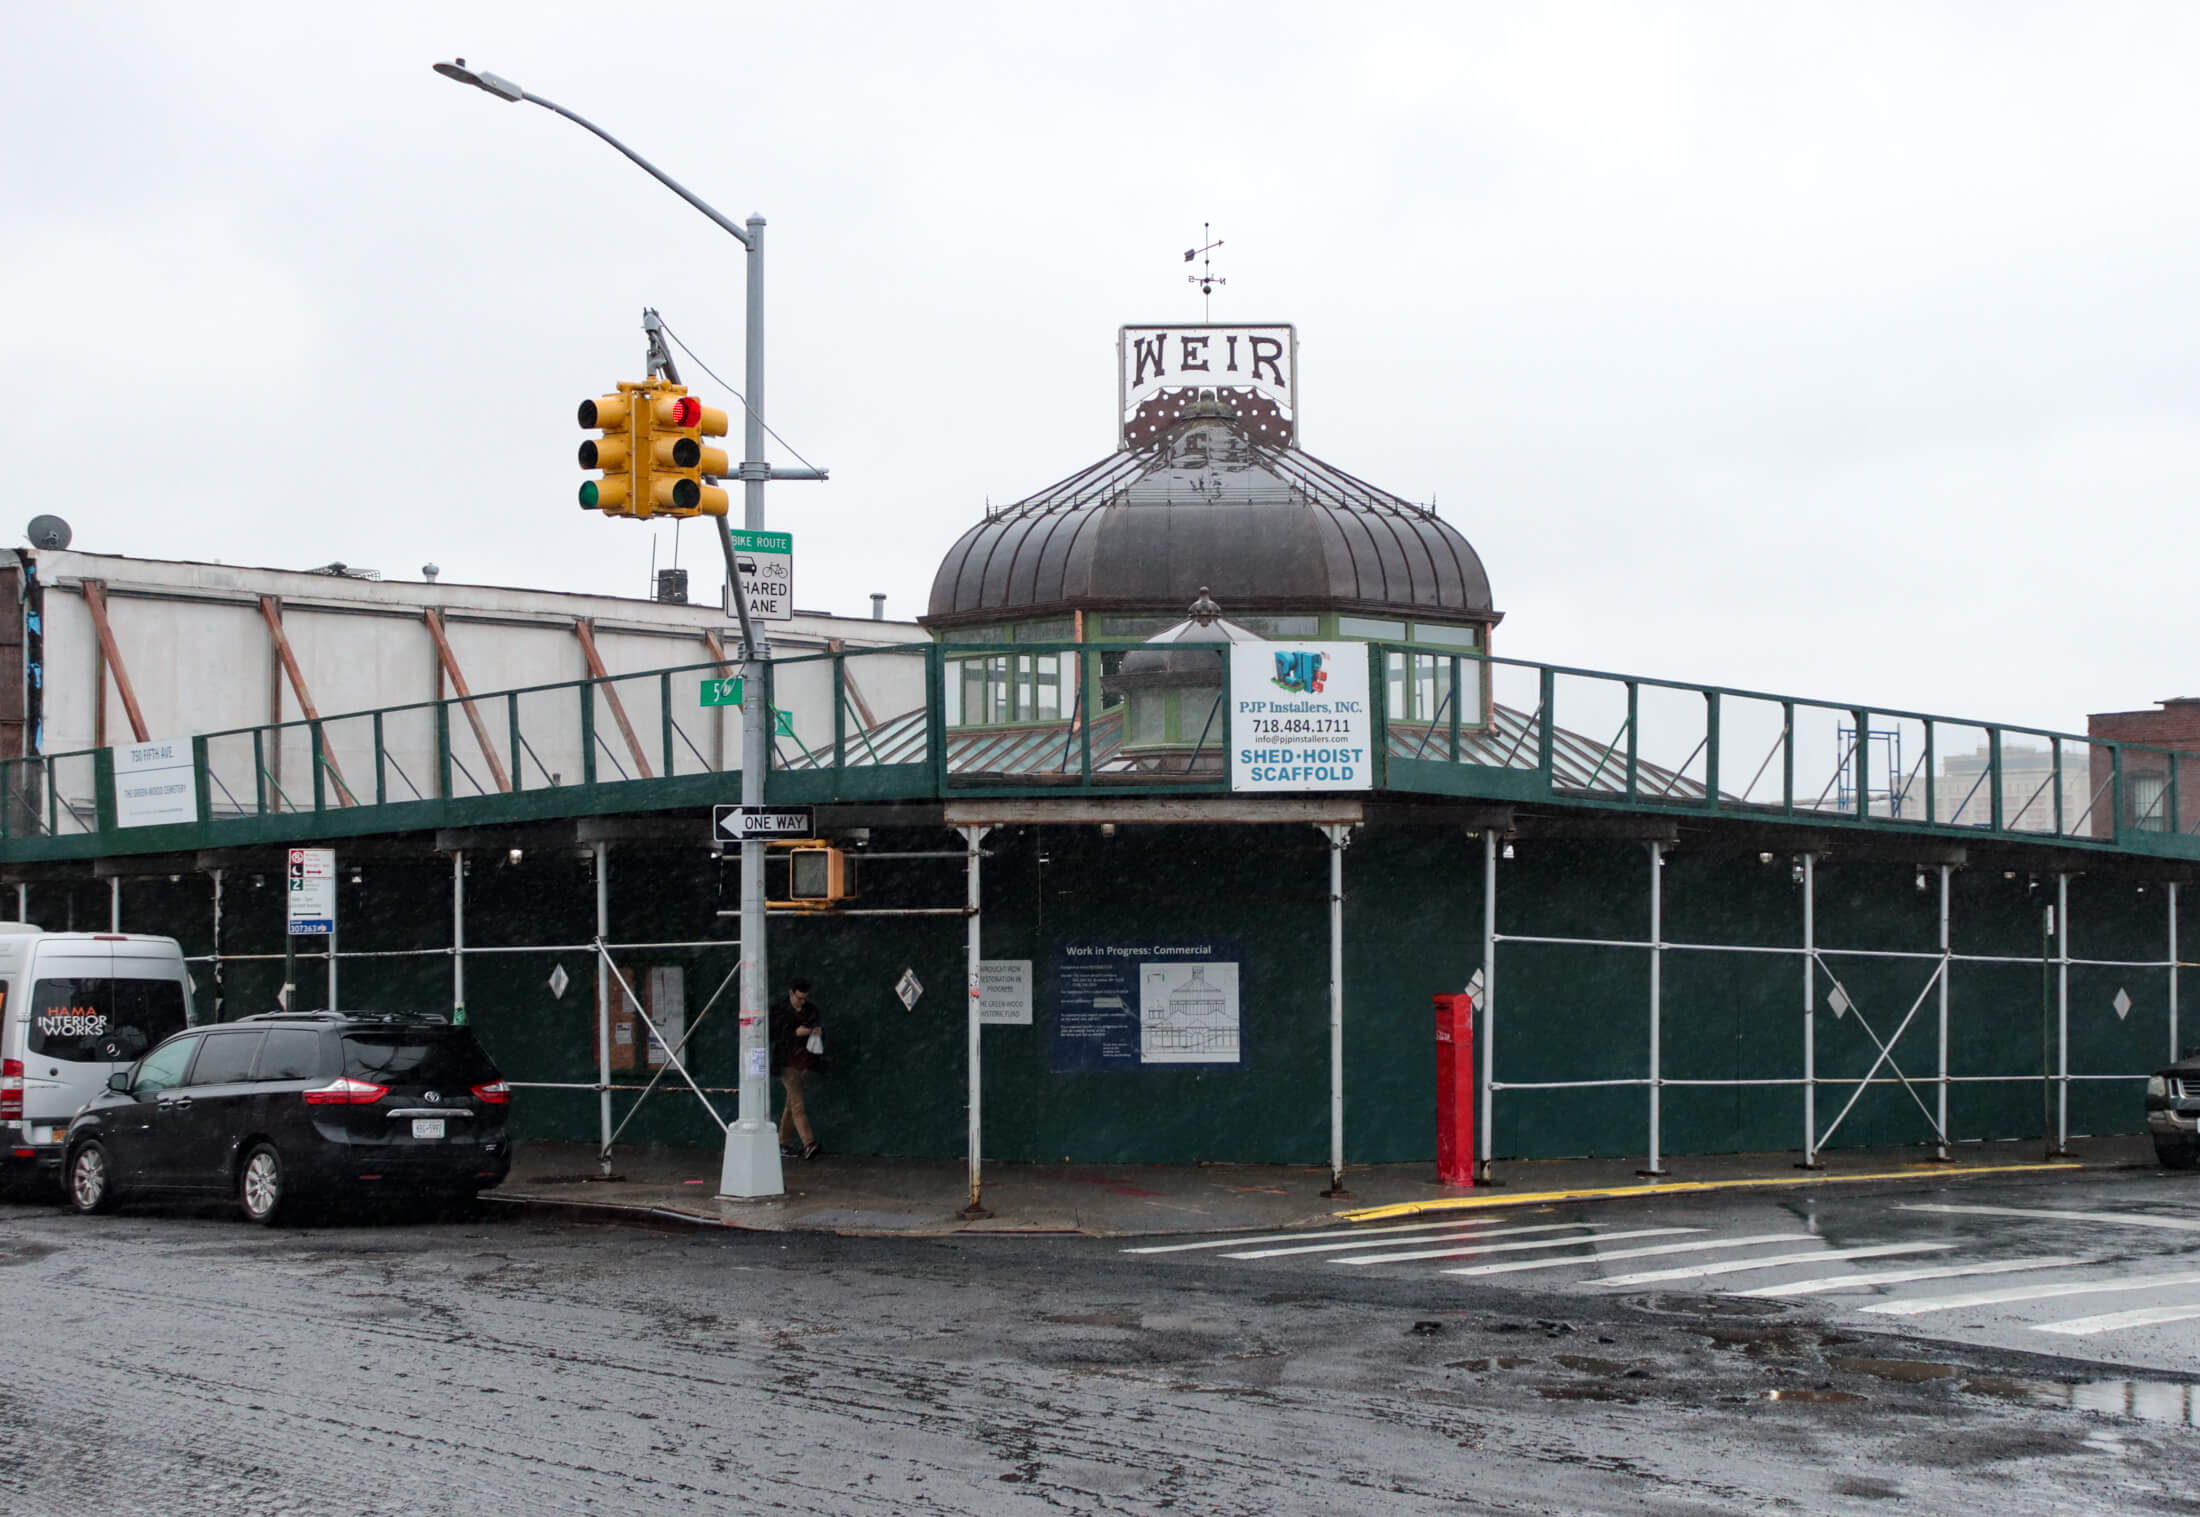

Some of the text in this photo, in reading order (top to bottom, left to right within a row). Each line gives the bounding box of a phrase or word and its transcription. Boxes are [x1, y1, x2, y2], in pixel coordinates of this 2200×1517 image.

[1133, 333, 1286, 388] WEIR
[732, 535, 787, 549] BIKE ROUTE
[743, 581, 787, 596] HARED
[750, 599, 777, 613] ANE
[1239, 701, 1363, 714] PJP Installers, INC.
[1252, 719, 1351, 733] 718.484.1711
[1255, 735, 1349, 745] info@pjpinstallers.com
[1250, 766, 1354, 782] SCAFFOLD
[745, 816, 804, 830] ONE WAY
[292, 879, 301, 890] 2
[1066, 945, 1212, 957] Work in Progress: Commercial
[47, 1005, 97, 1017] HAMA
[38, 1015, 108, 1027] INTERIOR
[42, 1024, 104, 1036] WORKS
